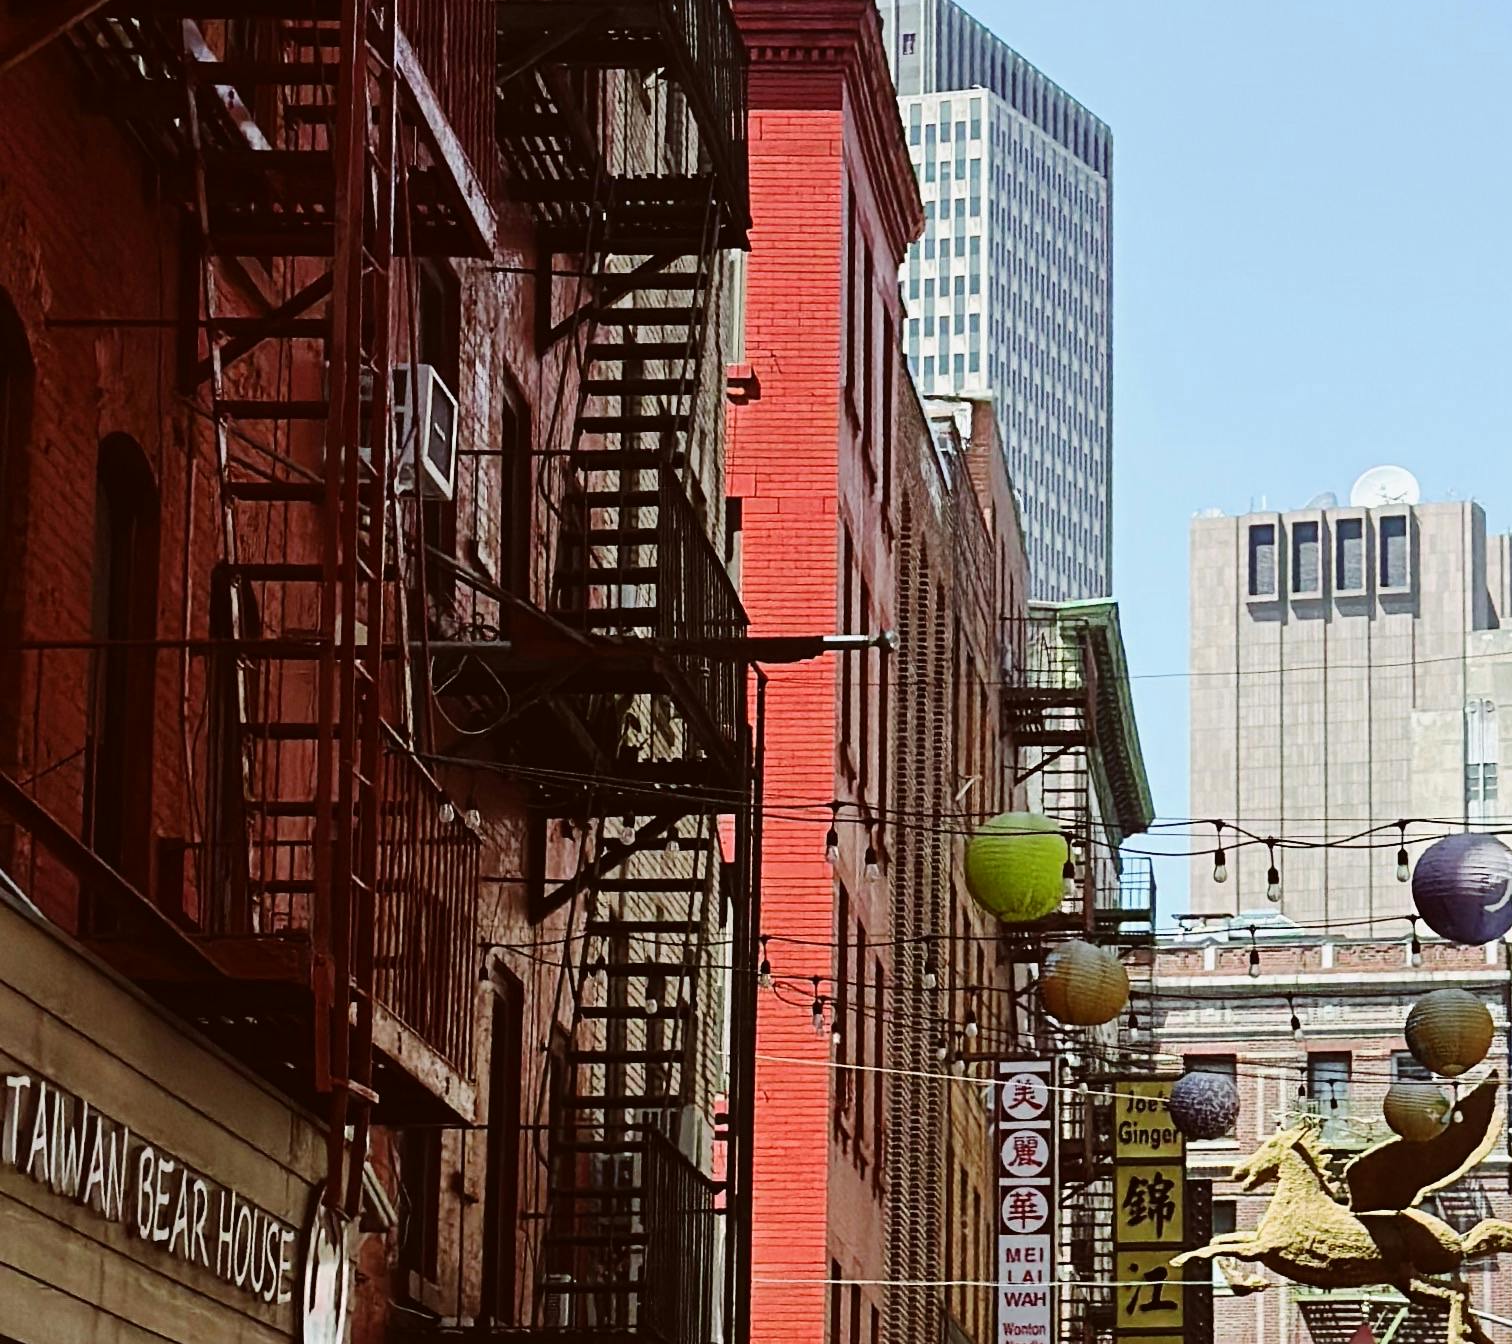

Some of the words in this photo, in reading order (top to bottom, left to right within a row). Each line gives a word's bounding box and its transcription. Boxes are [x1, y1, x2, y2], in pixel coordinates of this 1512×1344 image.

[1118, 1120, 1181, 1150] Ginger
[1002, 1076, 1047, 1230] 美麗華
[5, 1074, 129, 1222] TAIWAN
[137, 1146, 209, 1268] BEAR
[216, 1189, 295, 1305] HOUSE
[1005, 1247, 1044, 1263] MEI
[1003, 1292, 1046, 1308] WAH
